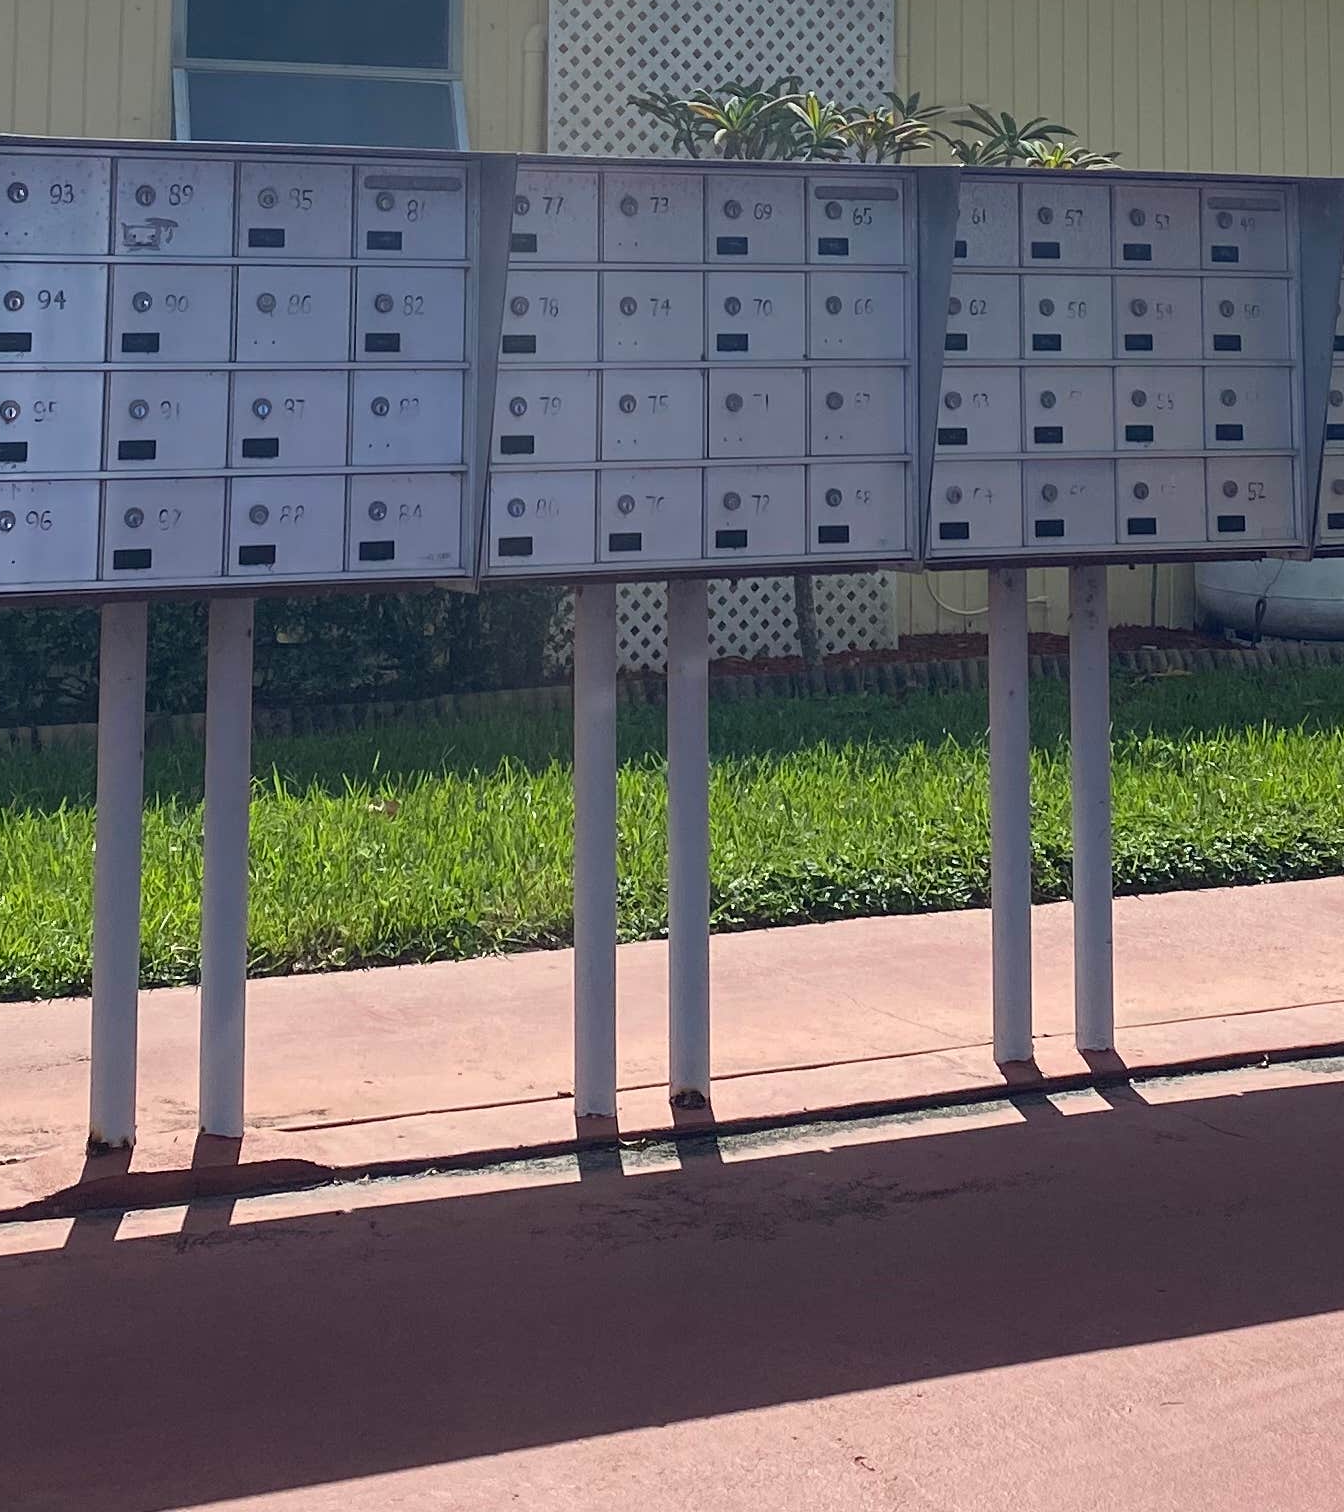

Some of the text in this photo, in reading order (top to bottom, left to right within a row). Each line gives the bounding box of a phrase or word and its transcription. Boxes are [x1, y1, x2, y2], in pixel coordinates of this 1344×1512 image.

[49, 183, 76, 205] 93
[168, 183, 194, 206] 89
[542, 196, 564, 216] 77
[650, 196, 670, 214] 73
[753, 202, 774, 221] 69
[852, 207, 873, 226] 65
[971, 208, 987, 225] 61
[1064, 209, 1084, 229] 57
[37, 289, 67, 311] 94
[164, 294, 190, 314] 90
[404, 294, 426, 316] 82
[539, 297, 560, 318] 78
[650, 298, 672, 318] 74
[752, 298, 773, 317] 70
[969, 299, 988, 316] 62
[1247, 481, 1267, 501] 52
[25, 509, 53, 532] 96
